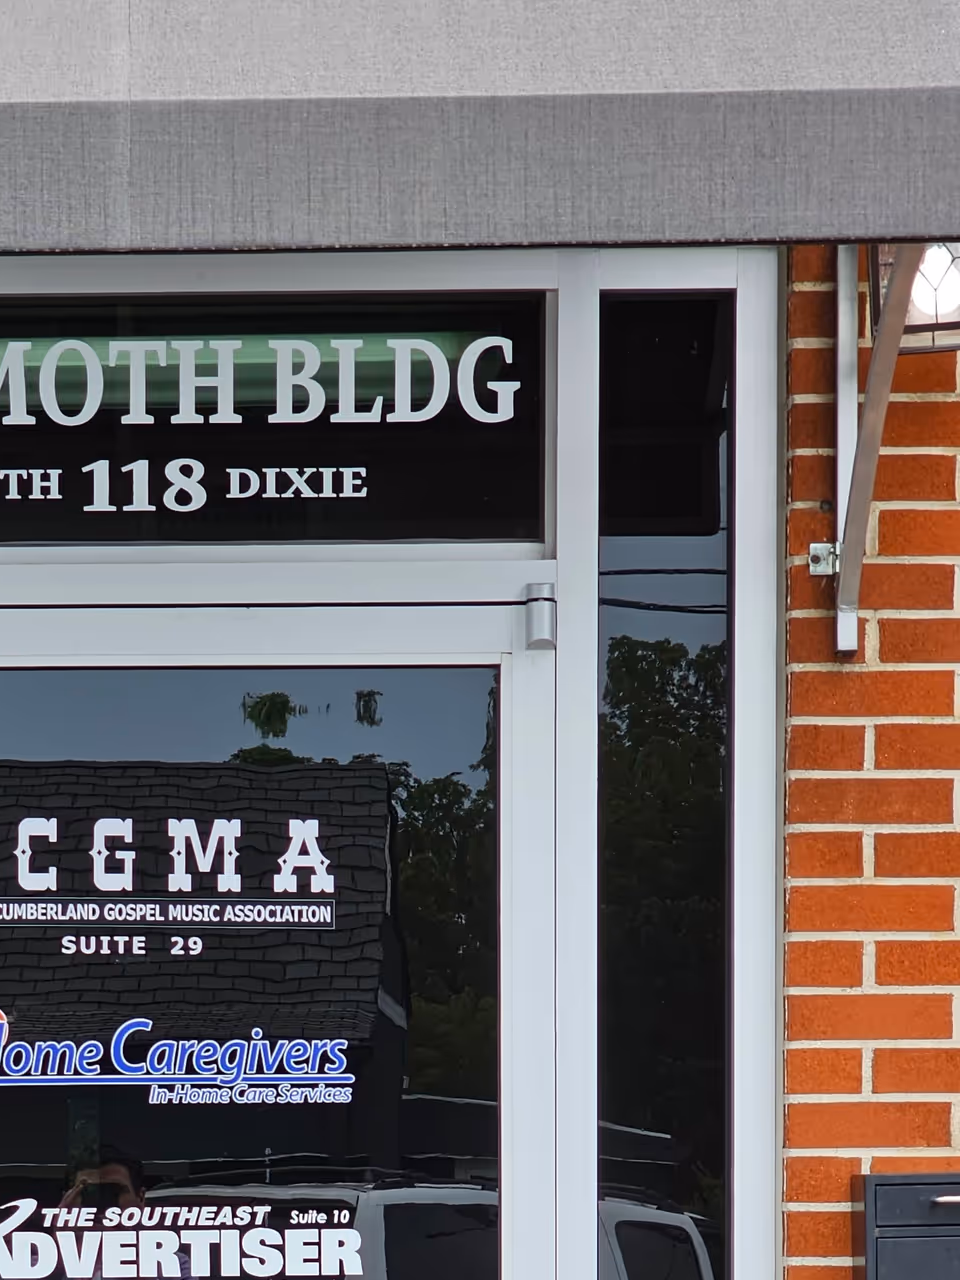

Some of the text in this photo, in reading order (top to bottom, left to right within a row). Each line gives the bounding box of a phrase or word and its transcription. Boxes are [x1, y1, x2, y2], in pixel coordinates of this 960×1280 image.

[268, 336, 521, 424] BLDG
[81, 458, 208, 512] 118
[226, 466, 368, 499] DIXIE
[103, 904, 164, 921] GOSPEL
[168, 904, 220, 922] MUSIC
[223, 904, 332, 923] ASSOCIATION
[61, 935, 203, 956] SUITE 29
[110, 1018, 349, 1085] Caregivers
[149, 1084, 352, 1104] In-Home Care Services
[41, 1205, 272, 1228] THE SOUTHEAST
[289, 1209, 350, 1226] Suite 10
